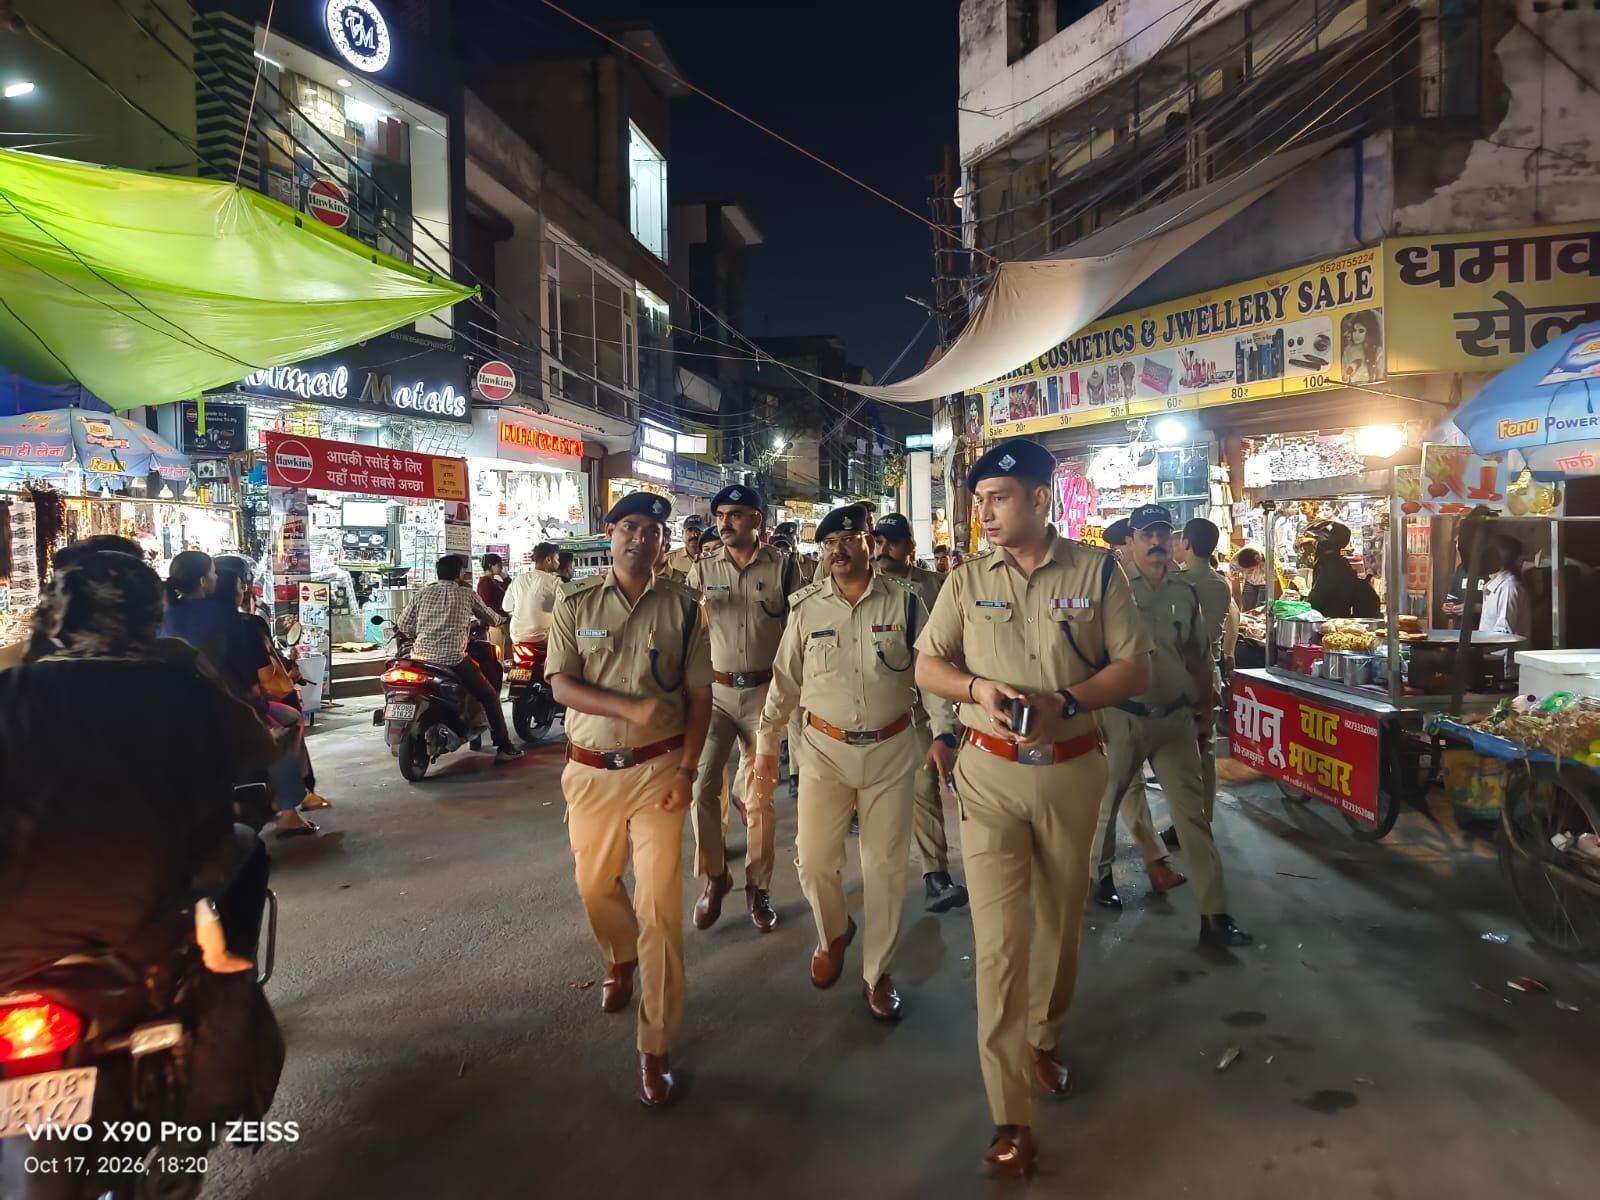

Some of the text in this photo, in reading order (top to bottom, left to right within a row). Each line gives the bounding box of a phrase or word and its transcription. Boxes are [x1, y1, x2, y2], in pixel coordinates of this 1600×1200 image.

[309, 194, 348, 213] Hawkins
[1319, 252, 1375, 273] 9528755224
[1038, 265, 1373, 371] COSMETICS & JWELLERY SALE
[479, 374, 514, 388] Hawkins
[360, 372, 466, 417] Metals
[989, 427, 1003, 437] Sale
[1498, 417, 1600, 440] Fena POWER
[0, 442, 65, 458] ना ही लेना
[276, 454, 313, 469] Hawkins
[327, 450, 423, 475] आपकी रसोई के लिए
[326, 468, 348, 486] यहाँ
[350, 470, 369, 488] पाएँ
[371, 473, 395, 488] सबसे
[398, 479, 424, 492] अच्छा
[1232, 686, 1286, 769] सोनू
[1299, 704, 1340, 746] चाट
[1289, 741, 1353, 797] भण्डार
